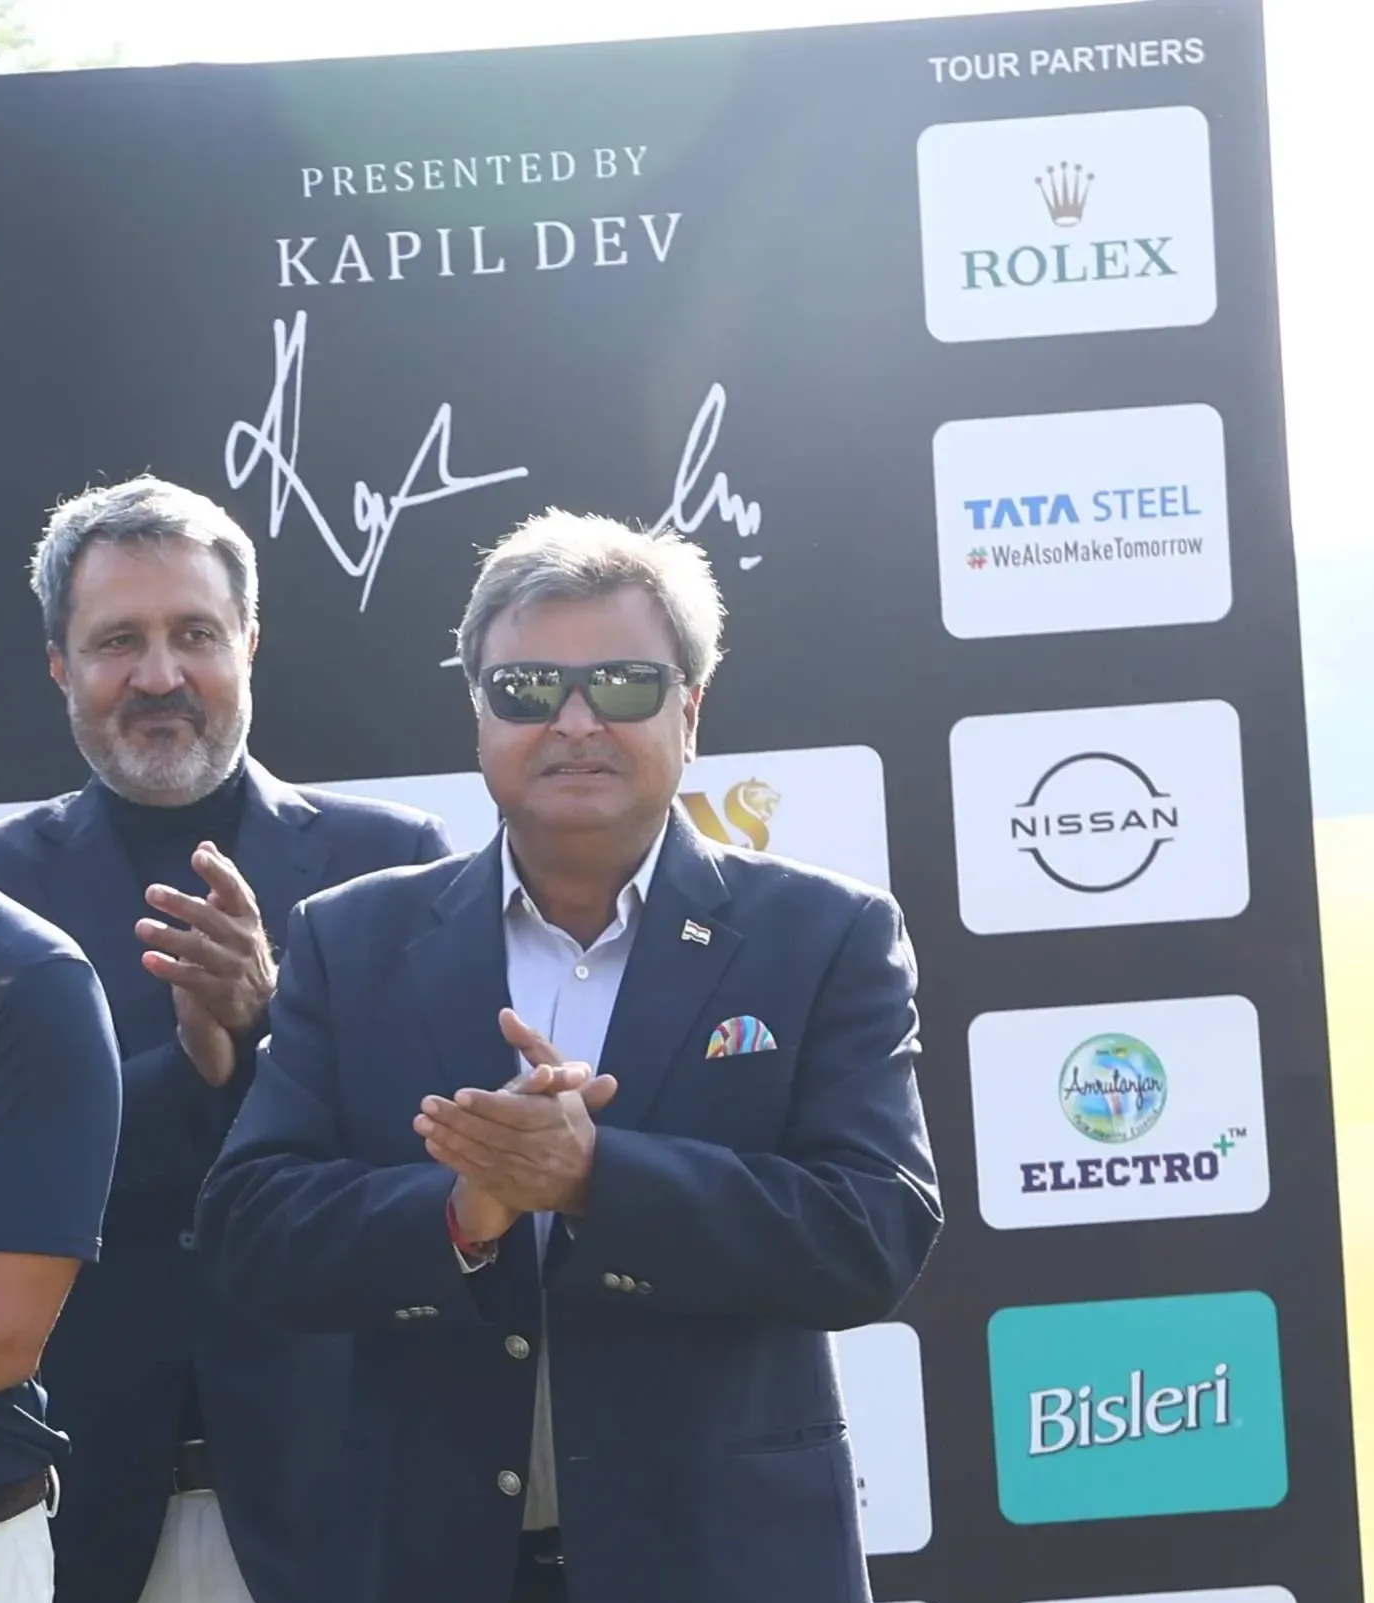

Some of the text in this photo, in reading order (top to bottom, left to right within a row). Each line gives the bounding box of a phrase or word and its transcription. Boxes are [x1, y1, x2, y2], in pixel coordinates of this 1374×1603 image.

[927, 37, 1206, 83] TOUR PARTNERS
[301, 145, 649, 198] PRESENTED BY
[275, 205, 683, 287] KAPIL DEV
[960, 236, 1178, 290] ROLEX
[963, 484, 1202, 530] TATA STEEL
[966, 536, 1203, 569] #WeAlsoMakeTomorrow
[1011, 806, 1179, 839] NISSAN
[1028, 1362, 1230, 1457] Bisleri
